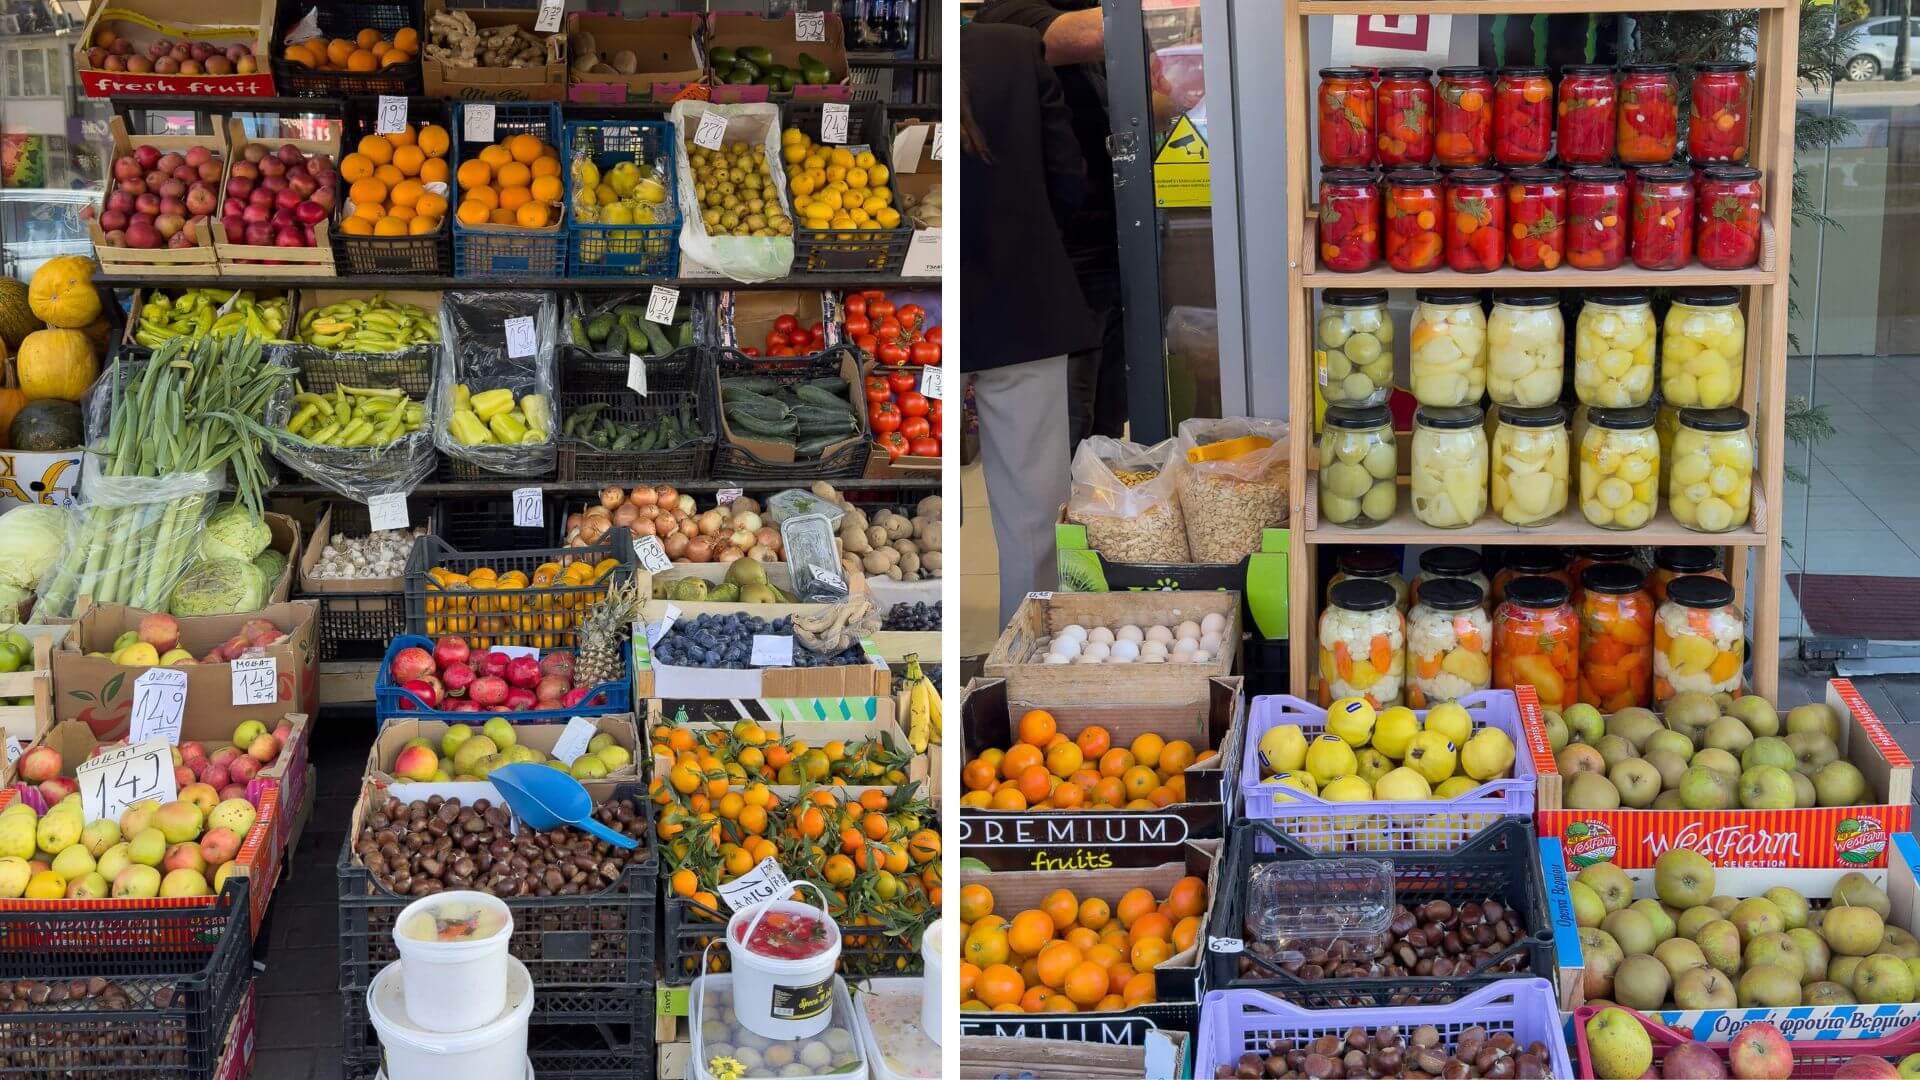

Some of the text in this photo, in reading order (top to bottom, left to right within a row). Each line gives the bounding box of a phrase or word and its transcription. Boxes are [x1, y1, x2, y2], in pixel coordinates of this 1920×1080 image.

[95, 79, 261, 94] fresh fruit
[1030, 849, 1113, 871] fruits
[1723, 860, 1787, 868] SELECTION
[1779, 1011, 1845, 1035] φρούτα
